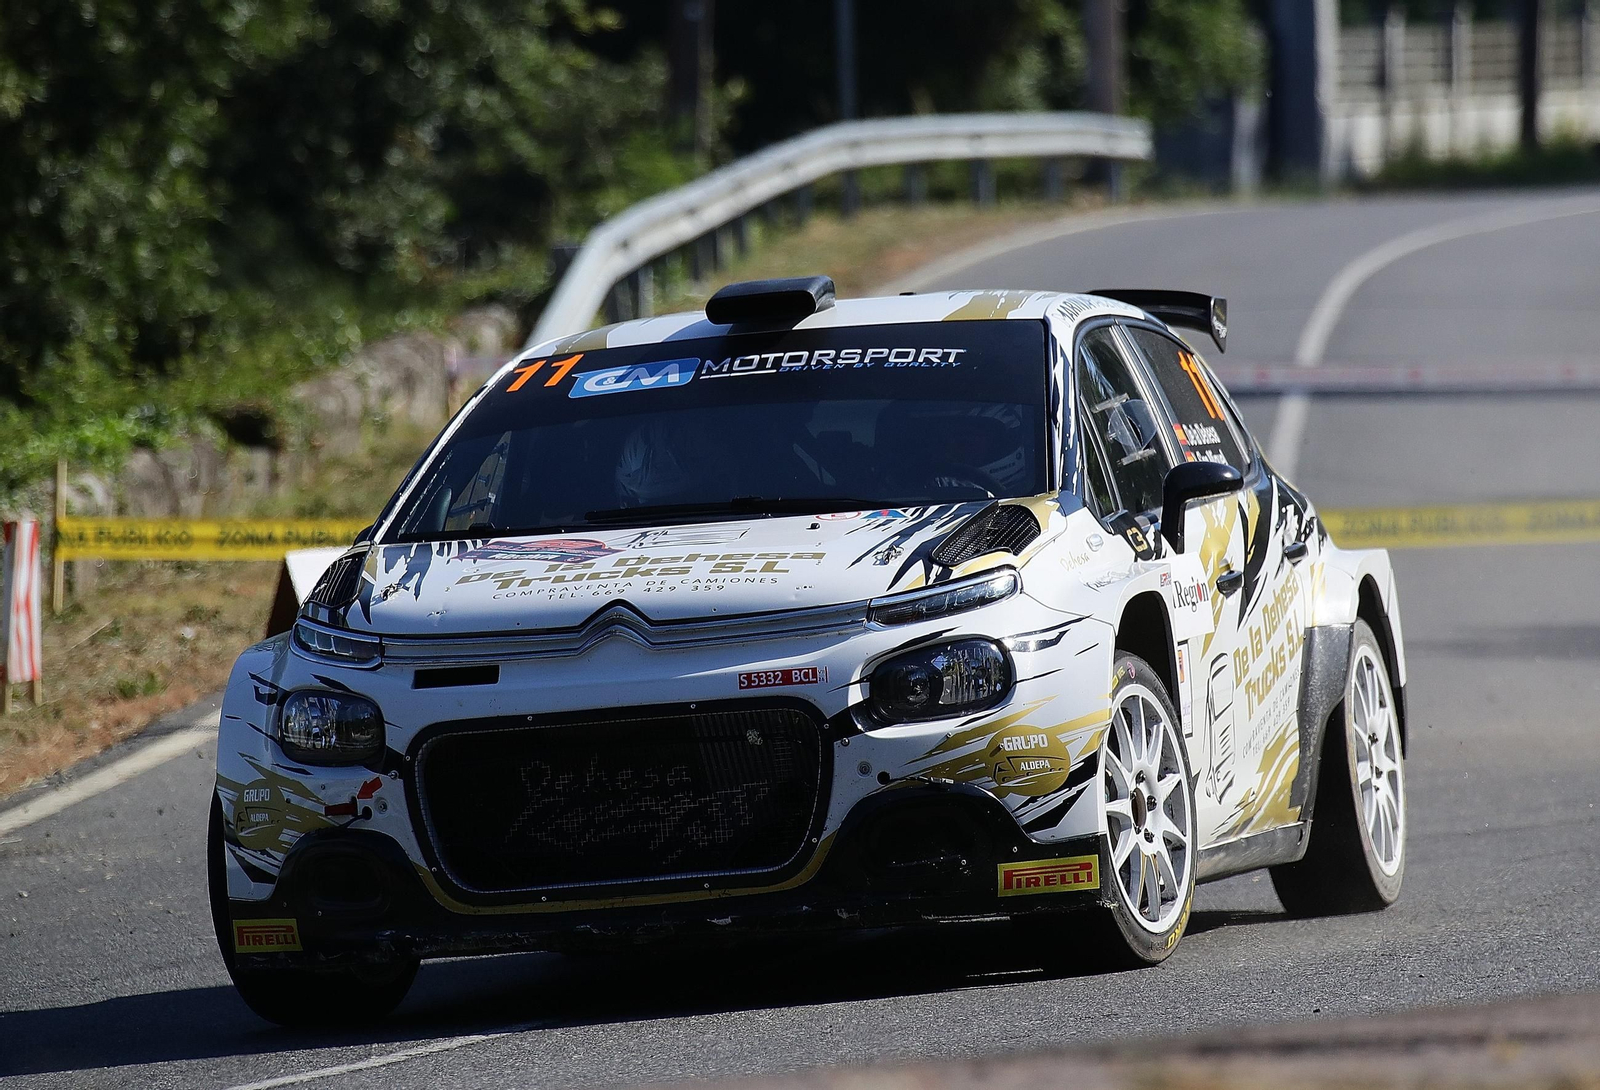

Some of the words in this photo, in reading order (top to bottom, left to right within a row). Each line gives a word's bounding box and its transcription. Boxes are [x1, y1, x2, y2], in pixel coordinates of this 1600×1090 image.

[506, 354, 585, 393] 11
[701, 348, 967, 375] MOTORSPORT
[779, 363, 846, 373] DRIVEN
[883, 361, 962, 369] QUALITY
[455, 569, 527, 586] De
[544, 562, 597, 574] la
[611, 552, 827, 569] Dehesa
[493, 565, 693, 590] Trucks
[708, 560, 790, 575] S.L
[492, 581, 633, 600] COMPRAVENTA
[645, 579, 668, 587] DE
[680, 576, 779, 586] CAMIONES
[547, 592, 584, 600] TEL.
[591, 588, 627, 597] 669
[643, 585, 678, 593] 429
[690, 584, 726, 593] 359
[1232, 647, 1250, 690] De
[1248, 625, 1264, 663] la
[1261, 566, 1300, 645] Dehesa
[740, 674, 749, 687] S
[751, 671, 783, 686] 5332
[792, 668, 817, 683] BCL
[1243, 640, 1287, 722] Trucks
[1003, 733, 1049, 752] GRUPO
[1020, 759, 1050, 771] ALDEPA
[243, 788, 271, 802] GRUPO
[250, 812, 270, 822] ALDEPA
[1003, 862, 1094, 891] PIRELLI
[236, 924, 297, 947] PIRELLI
